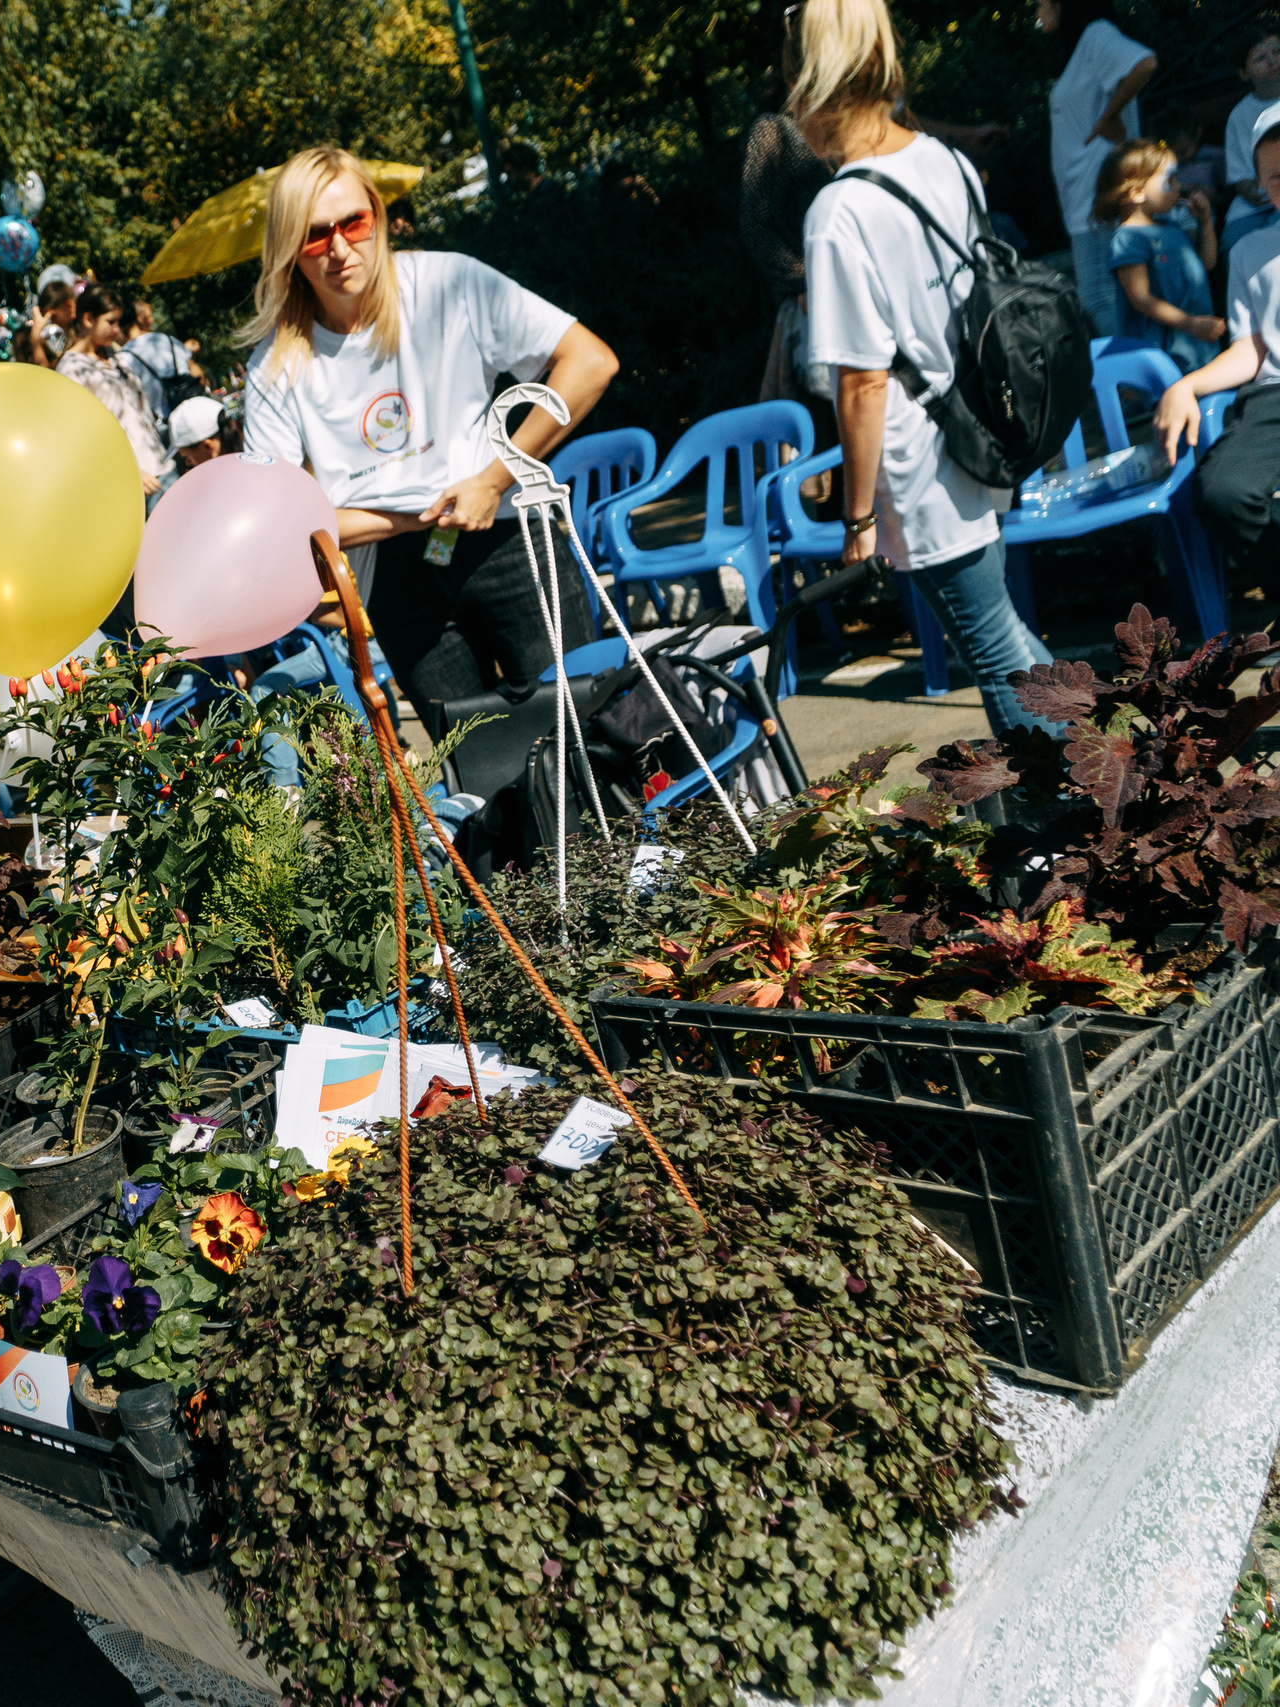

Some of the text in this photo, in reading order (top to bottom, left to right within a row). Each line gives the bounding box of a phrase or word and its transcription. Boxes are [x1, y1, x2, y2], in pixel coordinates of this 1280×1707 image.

[237, 1006, 261, 1022] 200
[585, 1102, 625, 1122] Условная
[337, 1116, 365, 1126] ДариДоб
[585, 1120, 607, 1132] цена
[556, 1126, 600, 1153] 700
